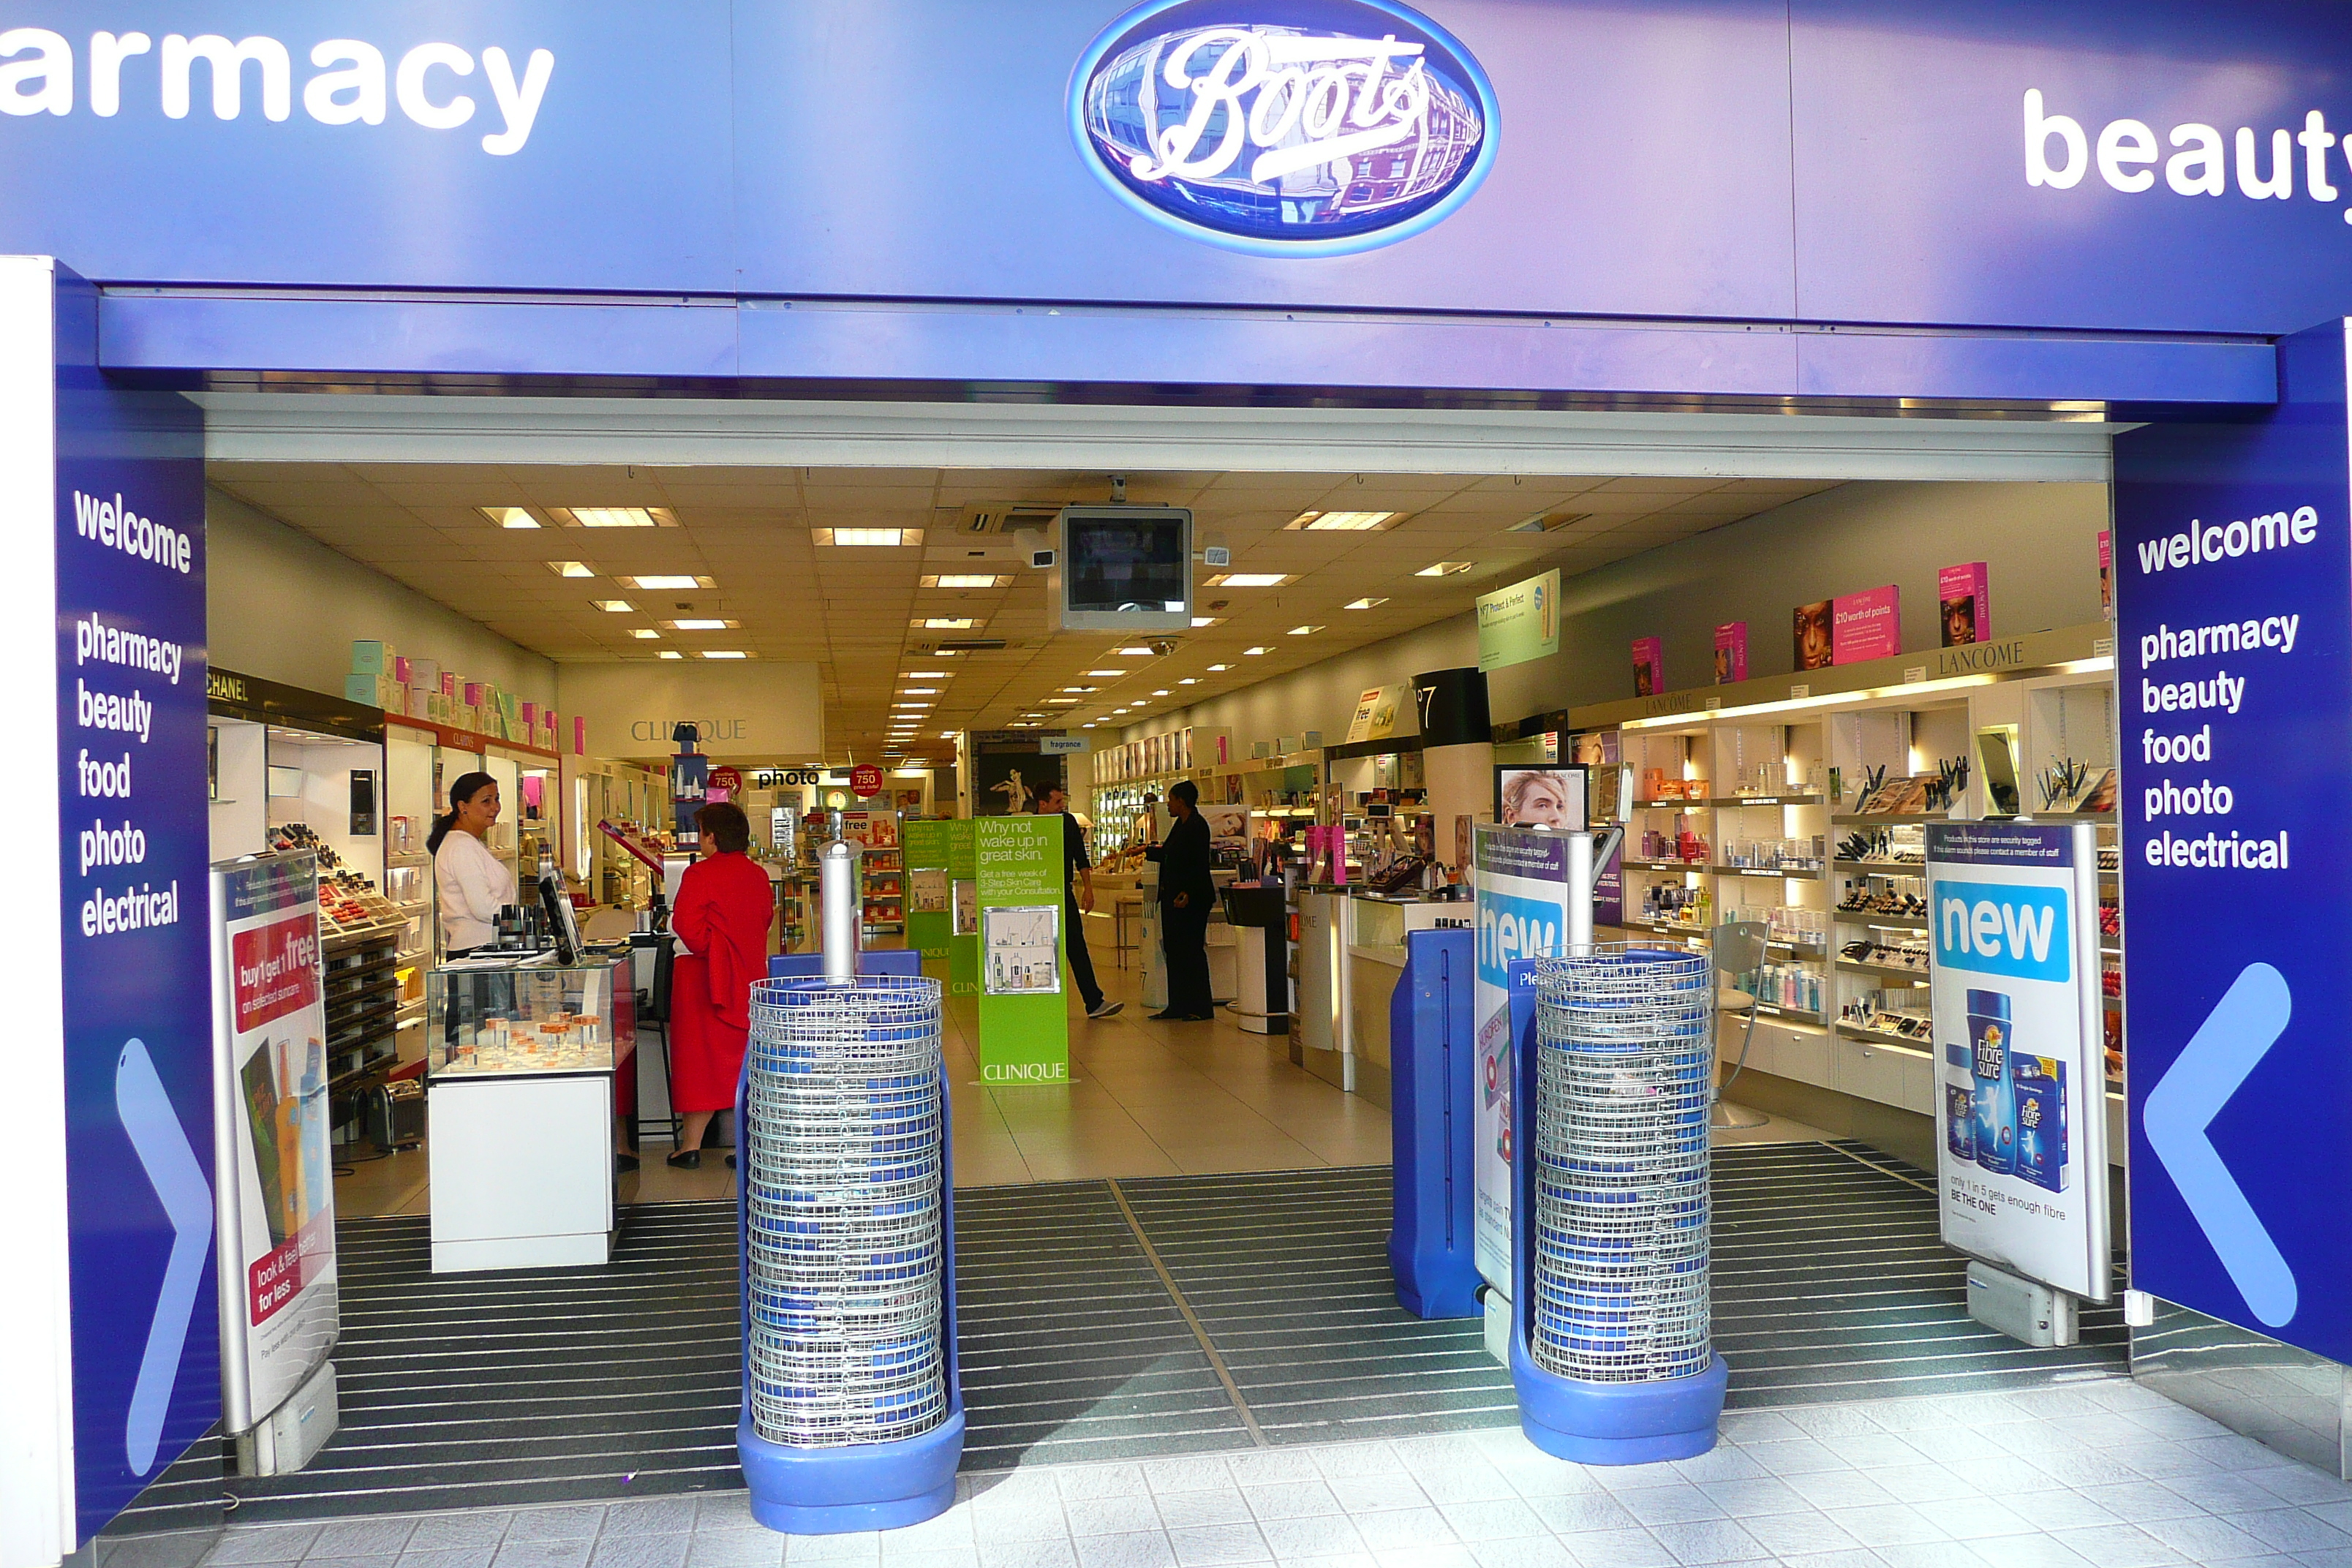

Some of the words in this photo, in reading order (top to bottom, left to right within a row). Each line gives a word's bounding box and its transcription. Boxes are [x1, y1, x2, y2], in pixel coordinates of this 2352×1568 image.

[0, 28, 555, 156] armacy
[1131, 28, 1425, 184] Boots
[75, 490, 192, 574] welcome
[2138, 505, 2318, 574] welcome
[1836, 611, 1847, 625] £10
[1848, 610, 1864, 622] worth
[1865, 608, 1872, 619] of
[1872, 604, 1891, 619] points
[78, 611, 182, 685] pharmacy
[2141, 614, 2299, 669] pharmacy
[1940, 641, 2024, 675] LANCÔME
[2143, 671, 2245, 714] beauty
[78, 678, 152, 744] beauty
[1049, 740, 1082, 749] fragrance
[2143, 725, 2211, 764] food
[79, 749, 130, 799] food
[715, 777, 735, 787] 750
[758, 769, 819, 789] photo
[856, 775, 875, 784] 750
[2145, 779, 2234, 822] photo
[845, 820, 867, 829] free
[950, 823, 970, 835] Why
[951, 832, 973, 841] wake
[979, 821, 1008, 837] Why
[1011, 822, 1032, 833] not
[81, 818, 146, 877] photo
[951, 841, 972, 851] great
[980, 835, 1015, 848] wake
[1017, 837, 1034, 850] up
[1037, 834, 1048, 846] in
[980, 850, 1014, 864] great
[1014, 848, 1043, 862] skin.
[1956, 847, 1973, 855] sounds
[1974, 847, 1989, 855] please
[1990, 848, 2010, 856] contact
[2014, 848, 2038, 856] member
[2038, 848, 2046, 856] of
[2046, 848, 2059, 857] staff
[2000, 836, 2021, 845] security
[2022, 837, 2042, 846] tagged
[2145, 831, 2288, 870] electrical
[979, 870, 994, 878] Get
[1001, 870, 1016, 878] free
[1039, 869, 1047, 877] of
[980, 878, 1006, 889] 3-Step
[1006, 878, 1022, 886] Skin
[1023, 878, 1041, 886] Care
[981, 888, 996, 896] with
[998, 889, 1014, 897] your
[1014, 886, 1061, 895] Consultation.
[82, 881, 178, 938] electrical
[1481, 908, 1555, 974] new
[1942, 897, 2054, 963] new
[241, 965, 260, 988] buy
[260, 960, 265, 981] 1
[266, 956, 280, 984] get
[281, 952, 286, 973] 1
[286, 931, 314, 971] free
[242, 1000, 252, 1014] on
[252, 987, 277, 1011] selected
[278, 983, 300, 1001] suncare
[1479, 1014, 1503, 1049] NUROFEN
[984, 1062, 1066, 1082] CLINIQUE
[1977, 1060, 2000, 1079] sure
[2042, 1066, 2053, 1075] SIZE
[2021, 1117, 2038, 1129] sure
[1950, 1175, 1965, 1190] only
[1967, 1179, 1971, 1190] 1
[1972, 1181, 1979, 1194] in
[1980, 1185, 1986, 1196] 5
[1988, 1188, 2005, 1203] gets
[2008, 1195, 2040, 1215] enough
[2043, 1203, 2066, 1221] fibre
[1951, 1188, 1961, 1202] BE
[1961, 1193, 1977, 1209] THE
[1978, 1199, 1997, 1215] ONE
[257, 1261, 278, 1288] look
[278, 1254, 285, 1274] &
[284, 1243, 298, 1269] feel
[298, 1231, 317, 1257] better
[258, 1291, 273, 1313] for
[274, 1278, 290, 1303] less
